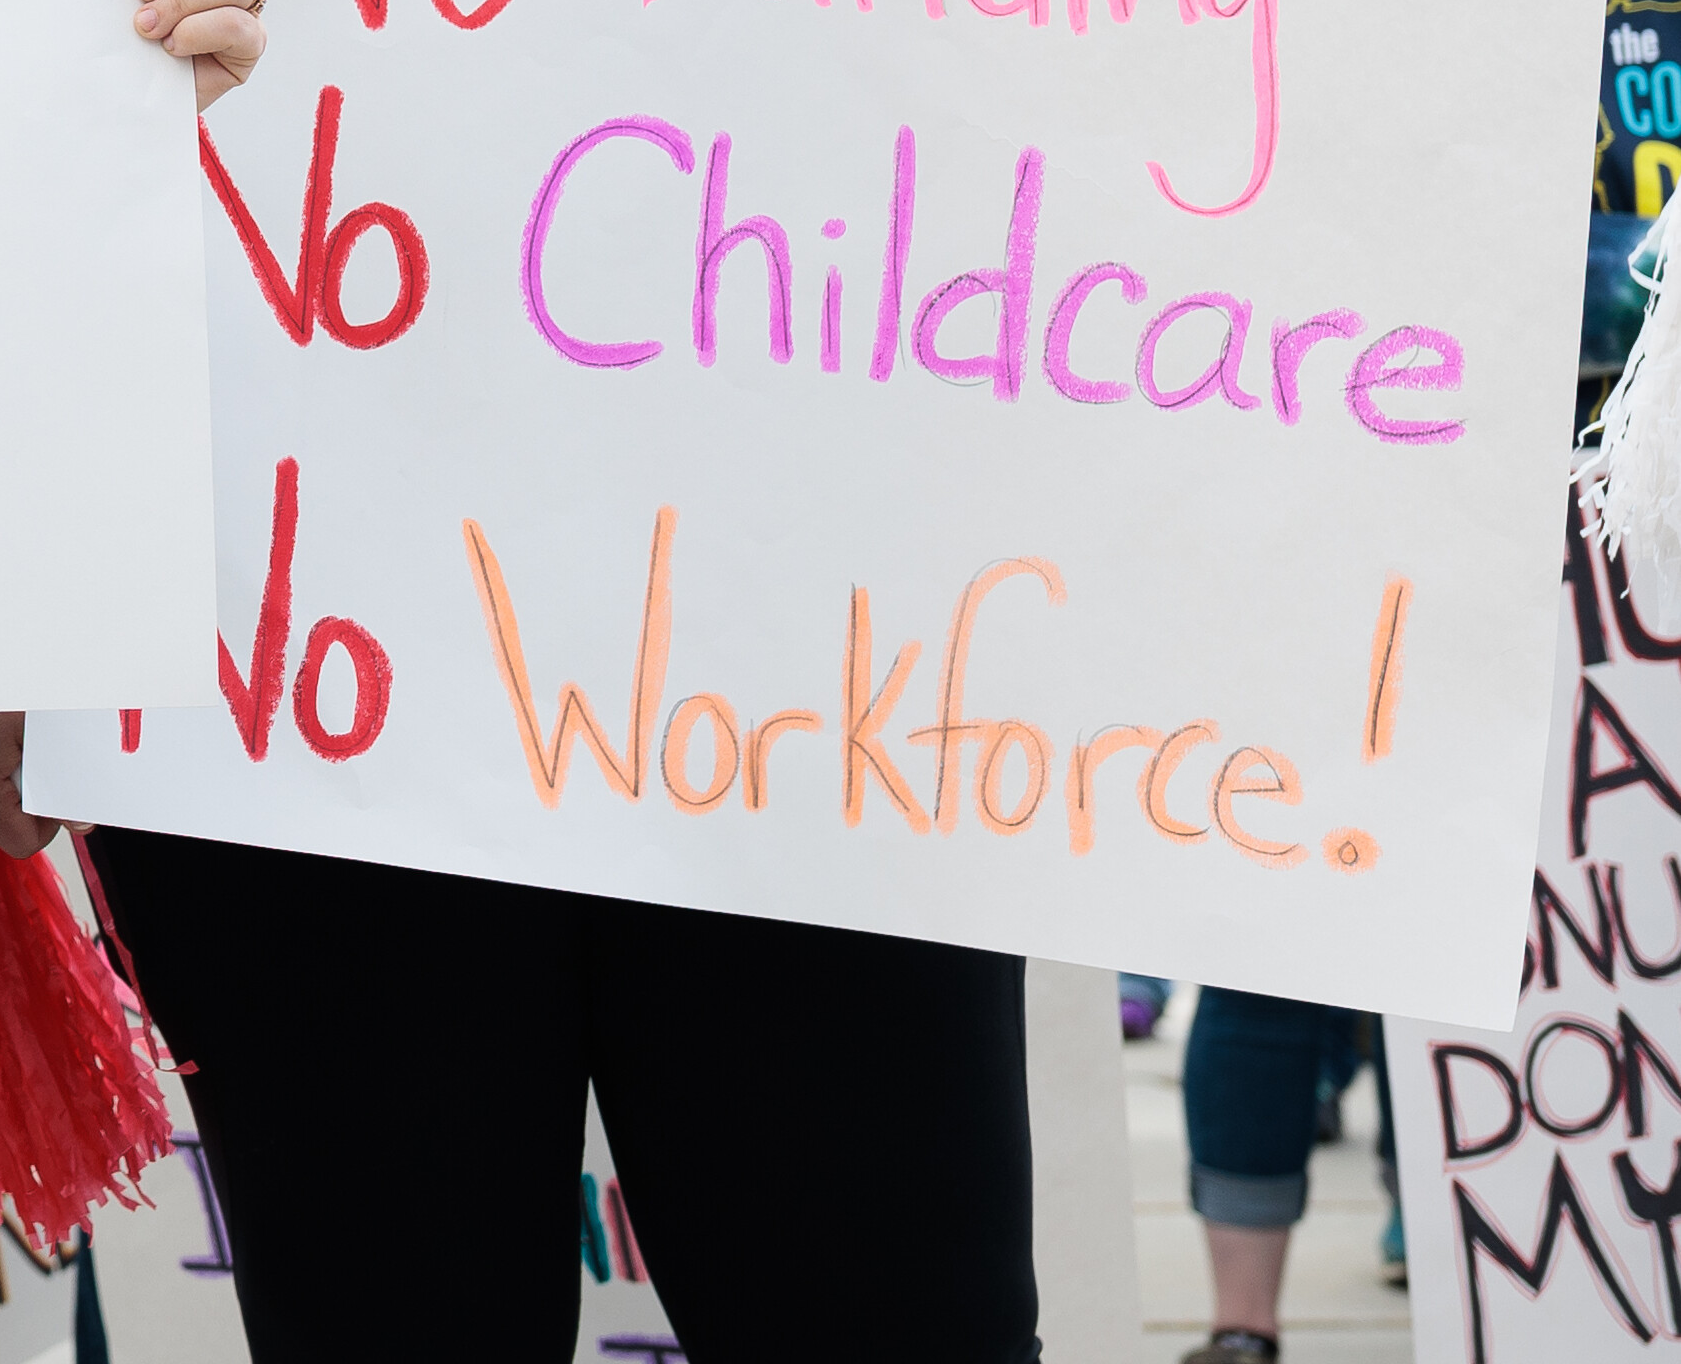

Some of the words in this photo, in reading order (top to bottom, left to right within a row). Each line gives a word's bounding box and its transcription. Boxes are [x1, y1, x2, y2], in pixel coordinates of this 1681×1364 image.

[1609, 22, 1660, 66] the
[519, 114, 1470, 447] Childcare
[462, 502, 1413, 874] Workforce!
[1519, 855, 1681, 1000] NU
